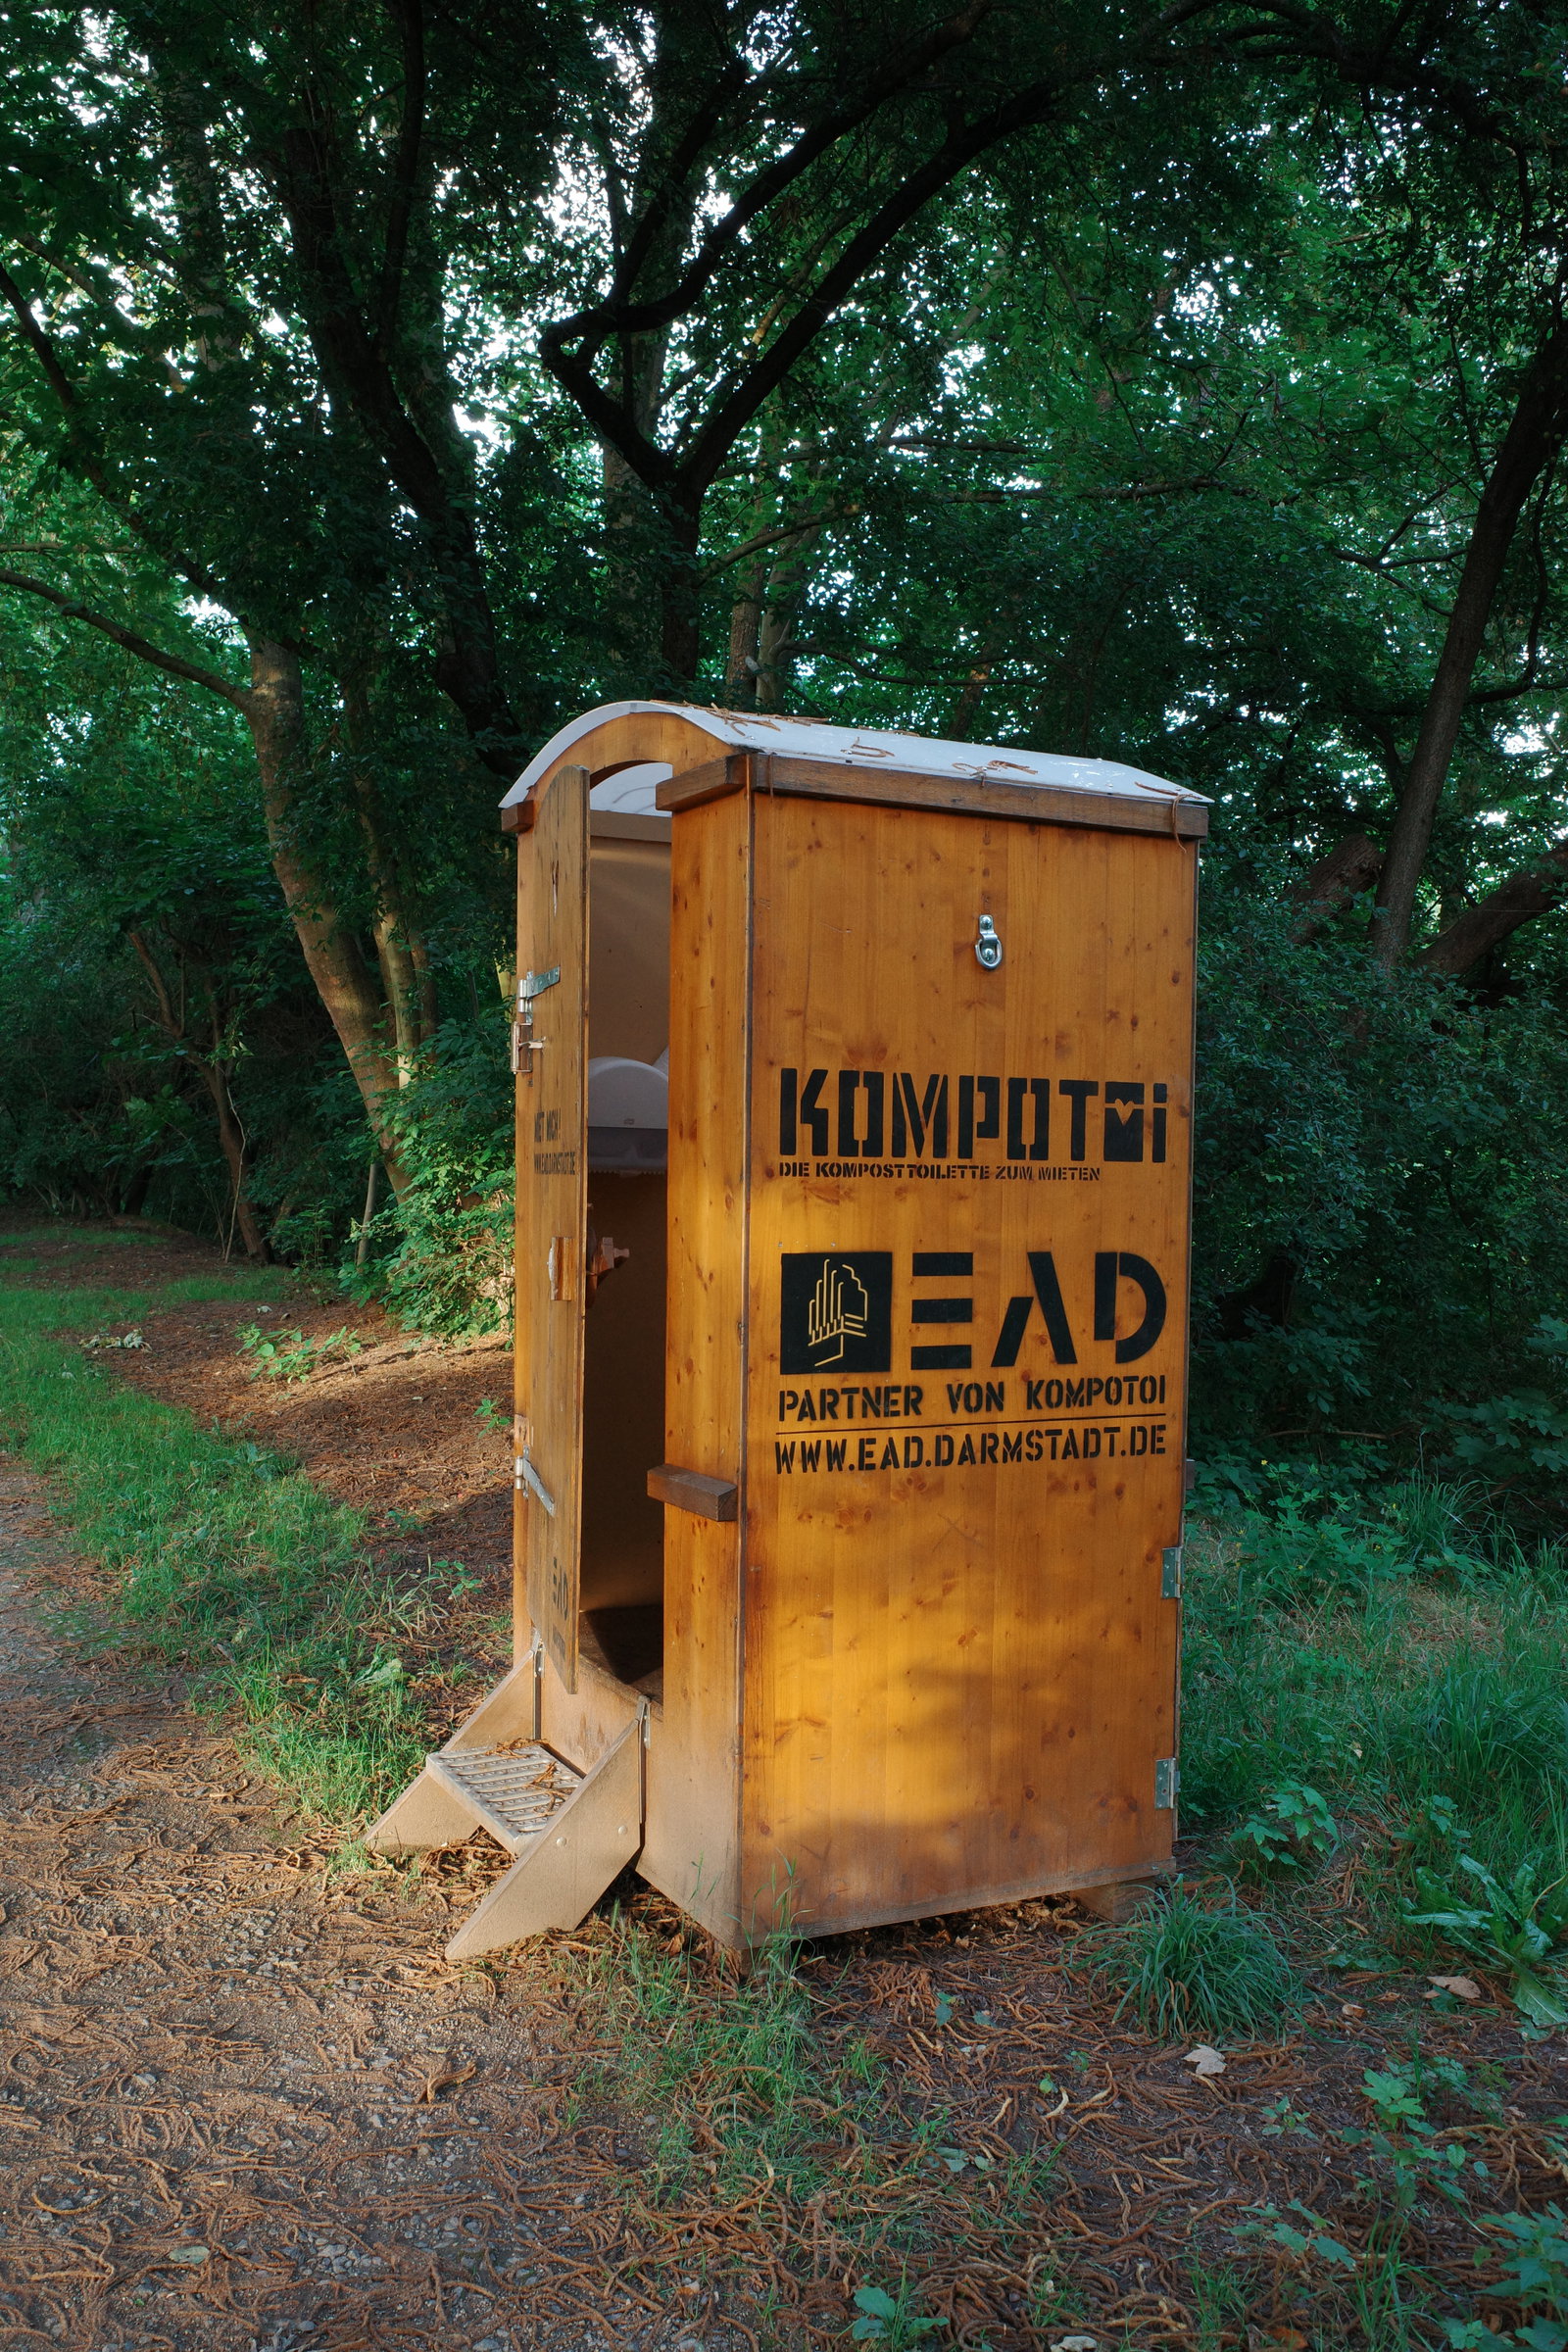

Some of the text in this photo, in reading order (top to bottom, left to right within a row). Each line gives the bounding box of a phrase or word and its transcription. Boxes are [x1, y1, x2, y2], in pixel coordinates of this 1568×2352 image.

[779, 1161, 1101, 1182] DIE KOMPOSTTOILETTE ZUM MIETEN
[910, 1250, 1167, 1370] EAD
[779, 1374, 1166, 1422] PARTNER VON KOMPOTOI
[775, 1424, 1167, 1475] WWW.EAD.DARMSTADT.DE
